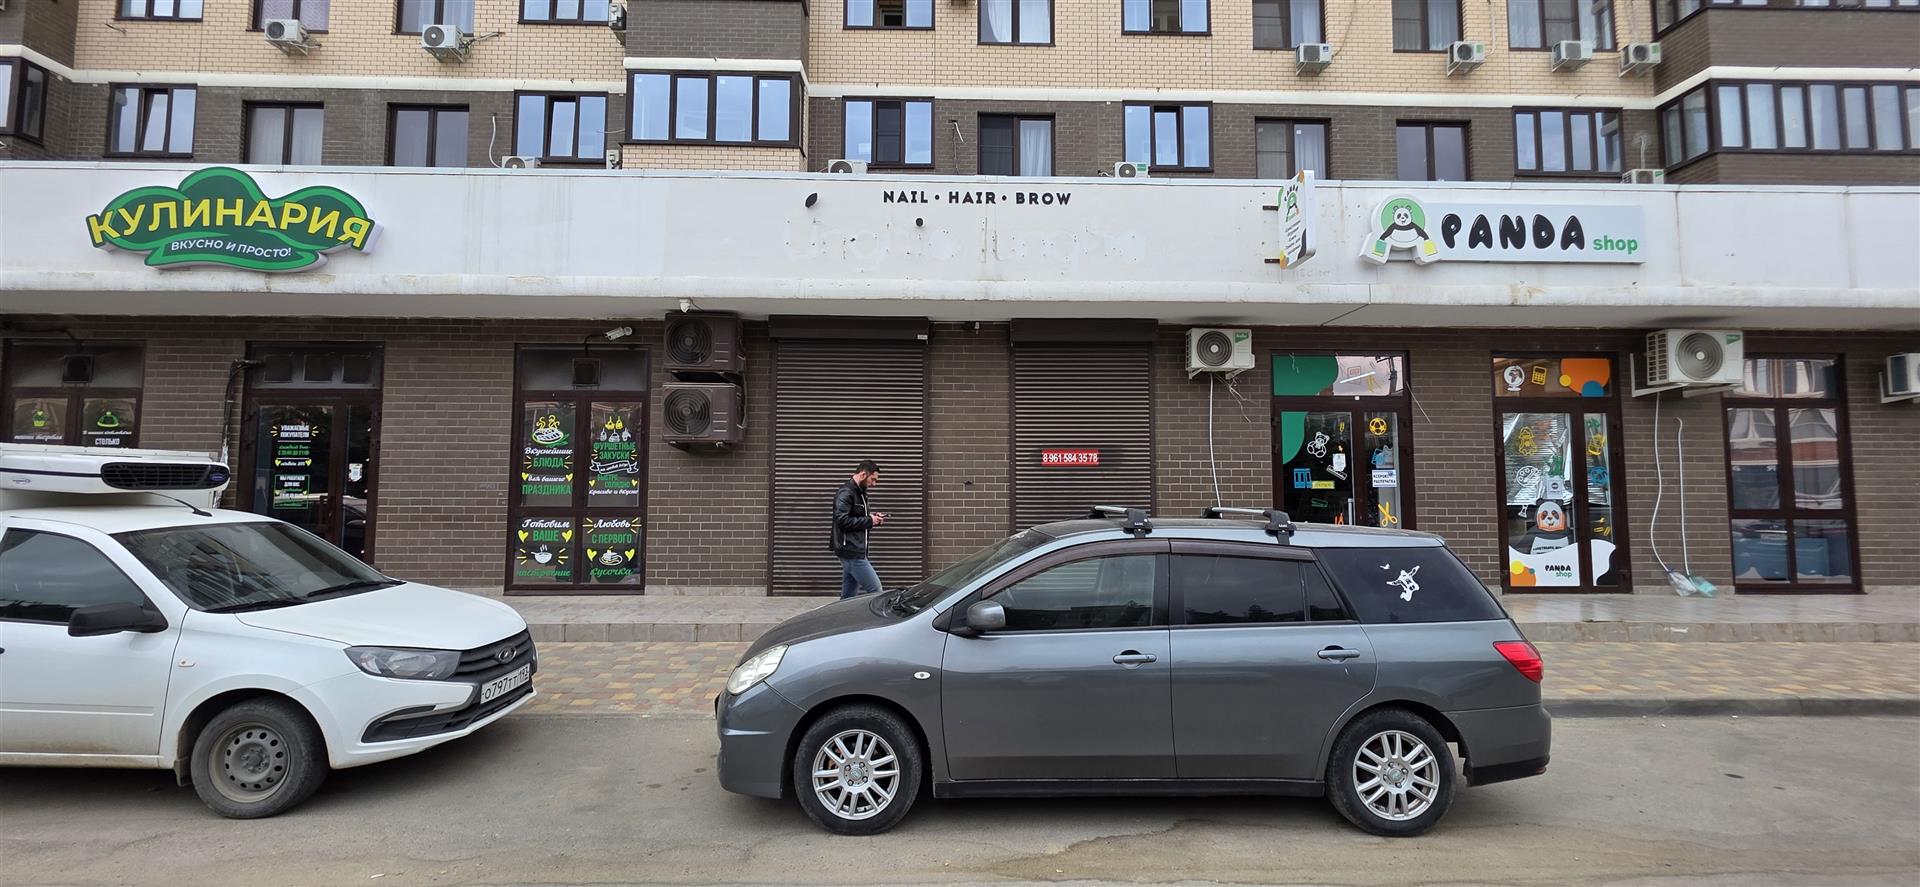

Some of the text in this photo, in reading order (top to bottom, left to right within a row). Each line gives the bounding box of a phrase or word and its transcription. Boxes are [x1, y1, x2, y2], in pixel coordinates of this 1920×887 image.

[883, 190, 1072, 206] NAIL HAIR BROW
[88, 197, 371, 248] КУЛИНАРИЯ
[1441, 213, 1639, 255] PANDA shop
[171, 239, 292, 259] ВКУСНО И ПРОСТО!
[524, 447, 574, 456] Вкуснейшие
[599, 451, 630, 460] ЗАКУСКИ
[533, 457, 564, 468] БЛЮДА
[1042, 453, 1098, 463] 8 961 584 35 78
[521, 484, 571, 495] ПРАЗДНИКА
[522, 518, 570, 528] Готовим
[594, 519, 631, 528] Любовь
[532, 530, 559, 542] ВАШЕ
[592, 534, 632, 544] С ПЕРВОГО
[1545, 564, 1572, 572] PANDA
[1556, 570, 1573, 579] shop
